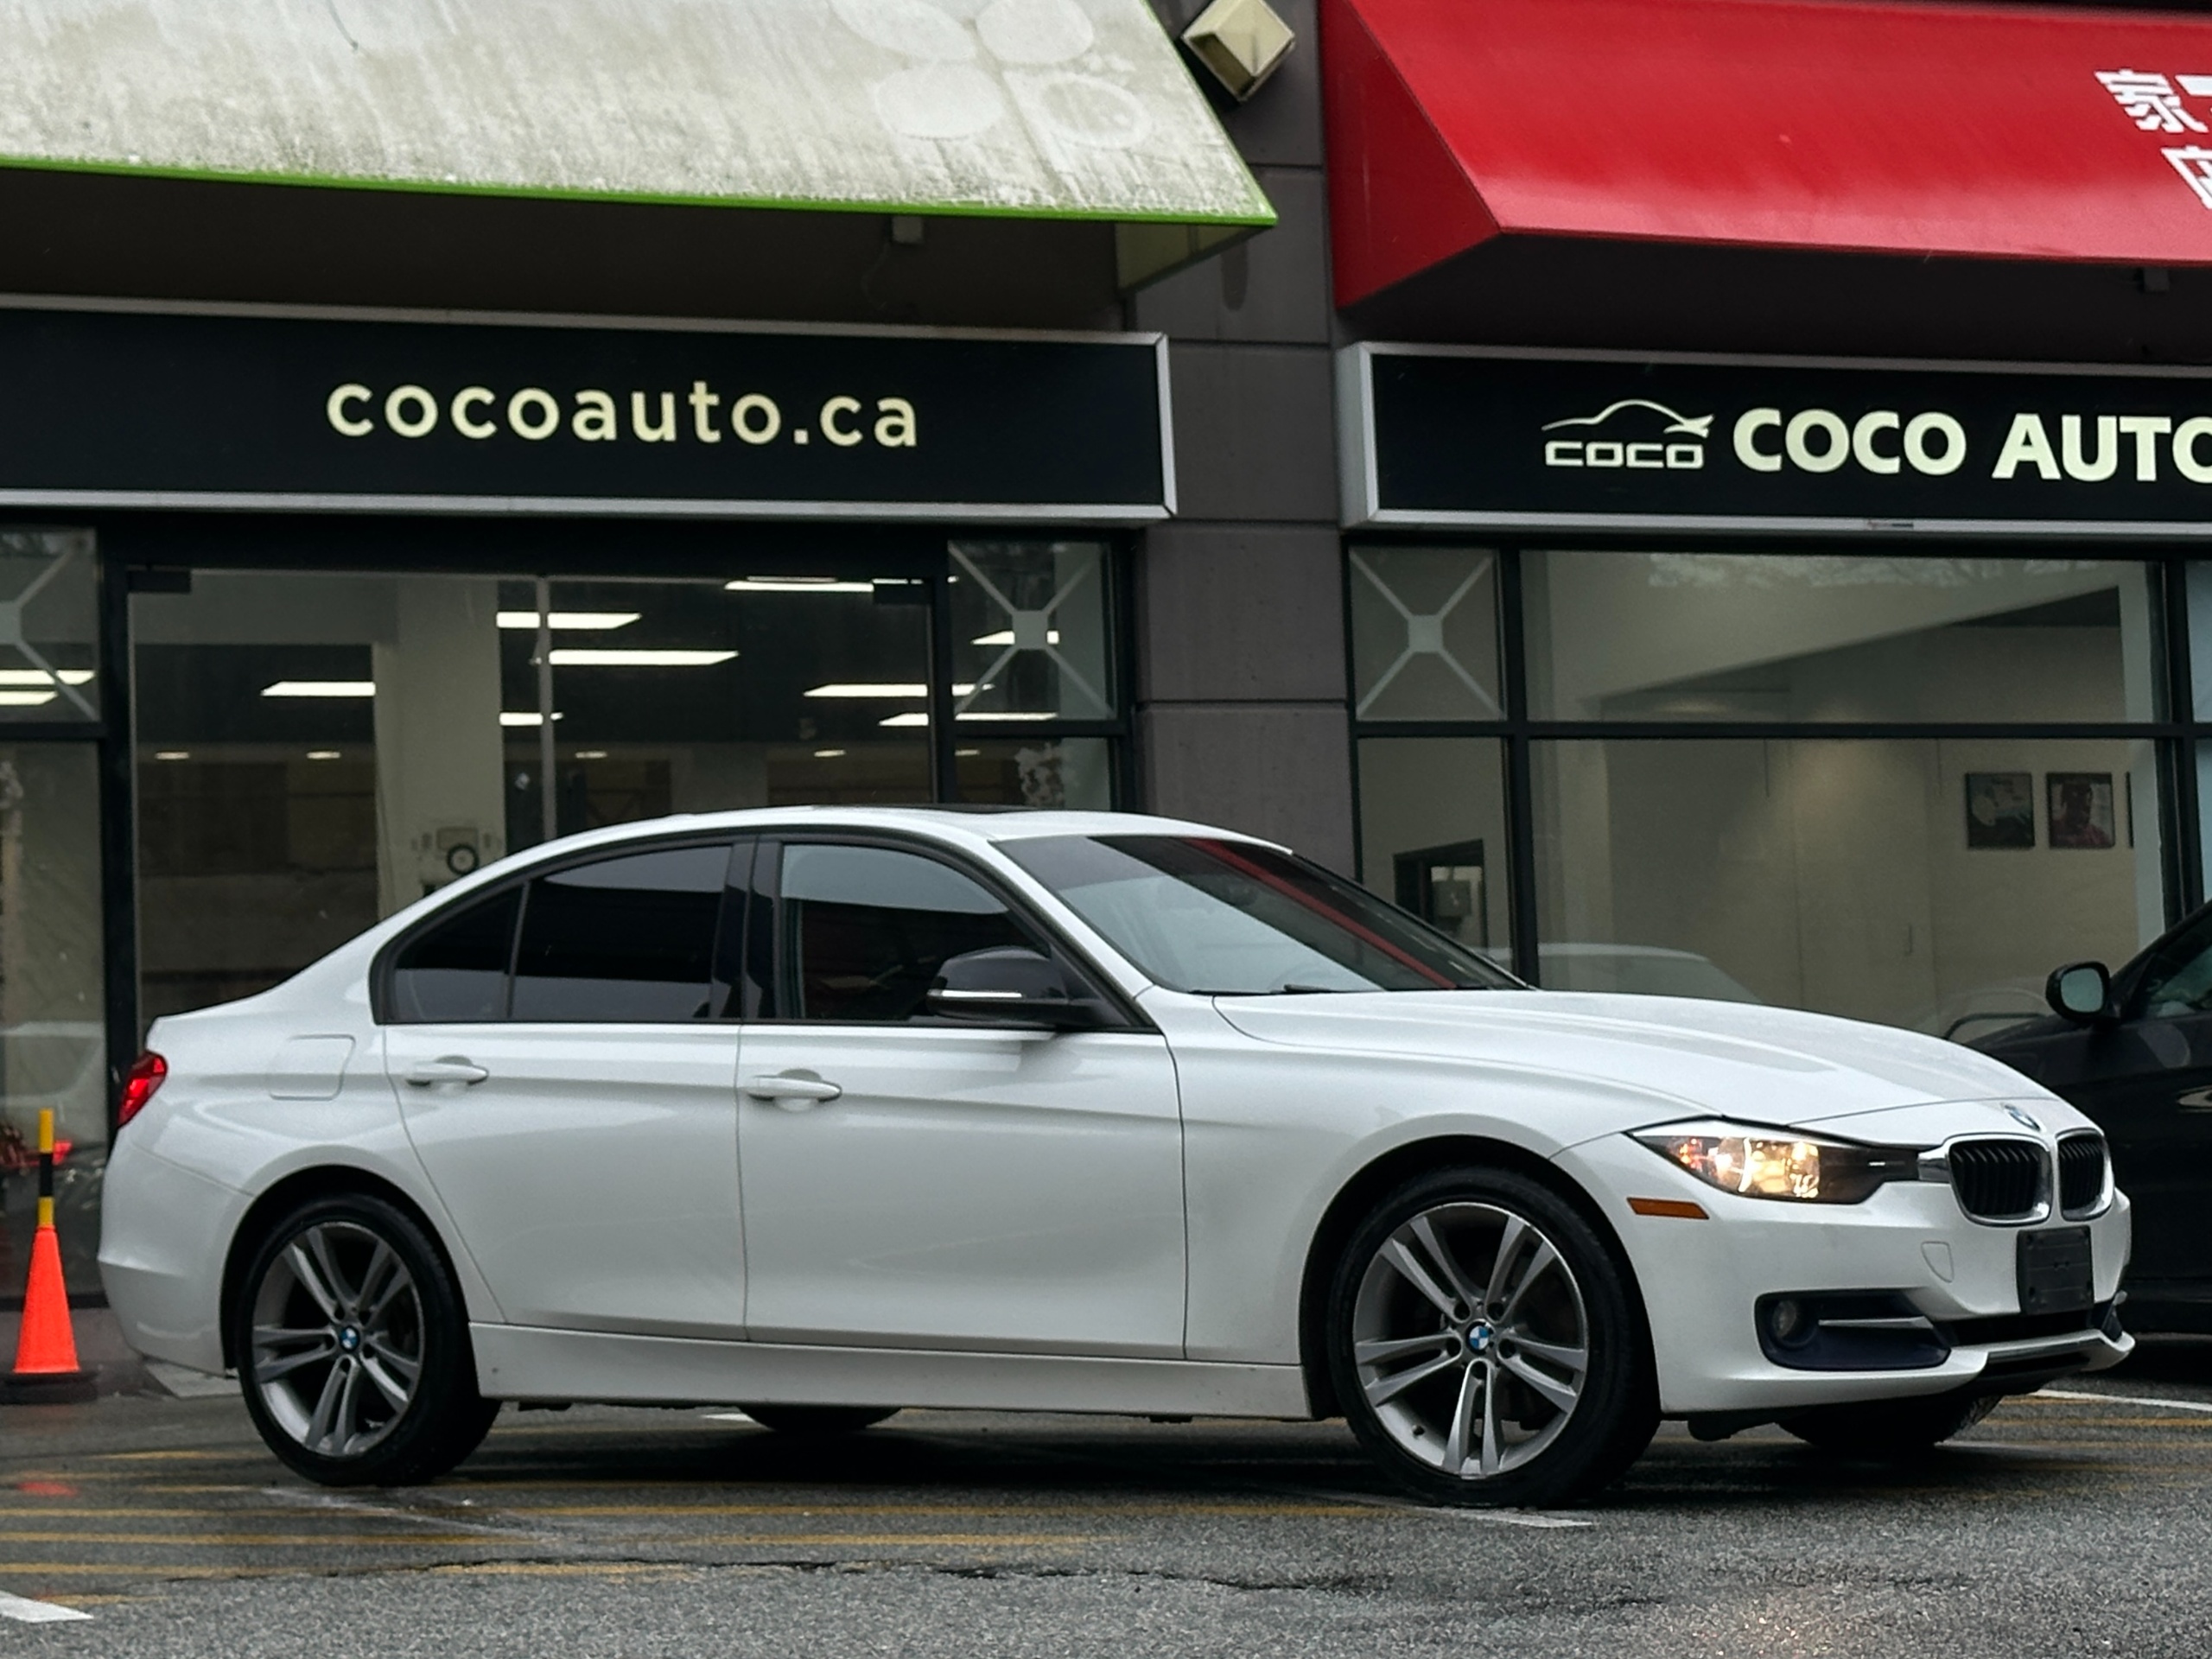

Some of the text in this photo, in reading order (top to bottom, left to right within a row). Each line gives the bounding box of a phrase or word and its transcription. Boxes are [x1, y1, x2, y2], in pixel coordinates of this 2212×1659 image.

[2094, 68, 2212, 133] 家
[327, 381, 918, 448] cocoauto.ca
[1732, 408, 2212, 484] COCO AUTO
[1545, 441, 1704, 469] COCO
